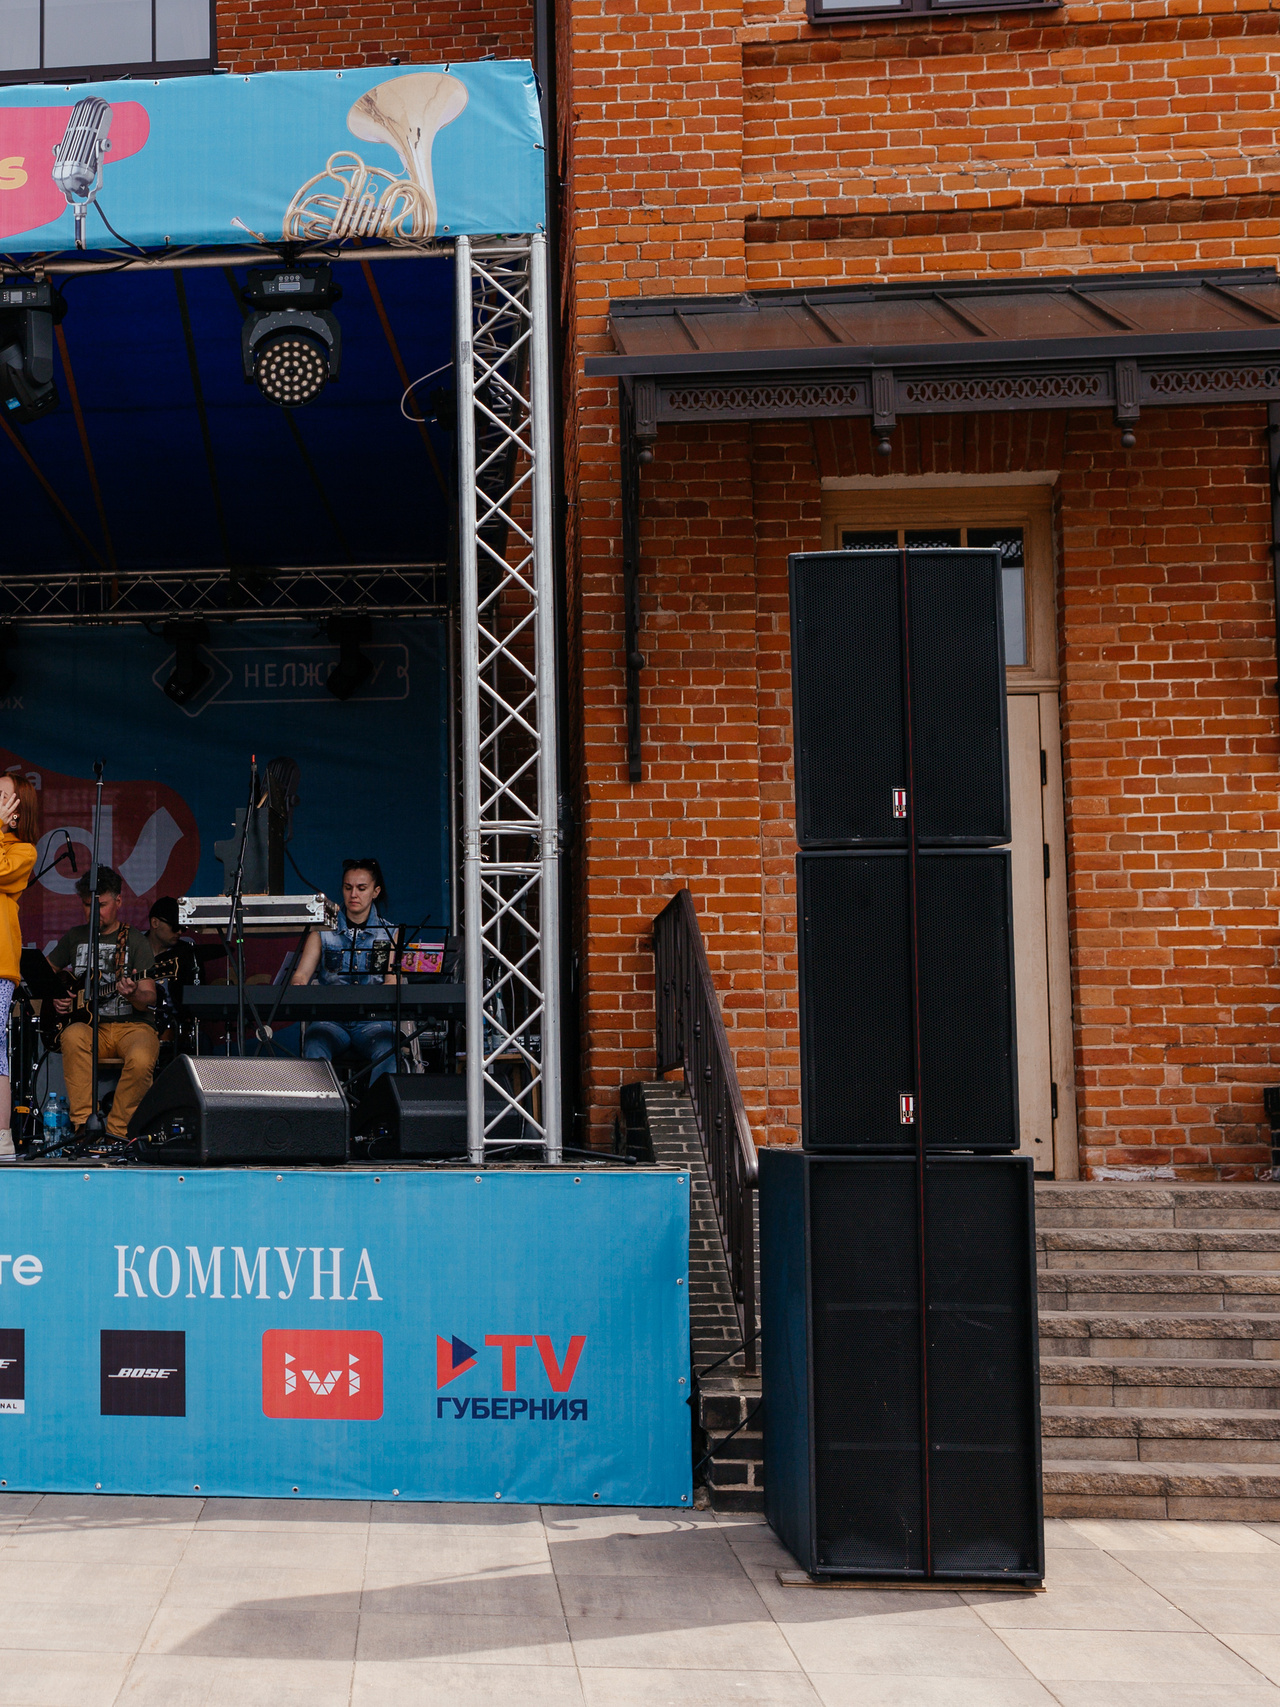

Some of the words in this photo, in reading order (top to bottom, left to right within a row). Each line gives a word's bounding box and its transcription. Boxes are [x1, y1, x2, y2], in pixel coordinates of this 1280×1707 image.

[114, 1245, 384, 1301] КОММУНА
[108, 1367, 178, 1379] BOSE
[484, 1334, 587, 1393] TV
[436, 1396, 589, 1422] ГУБЕРНИЯ
